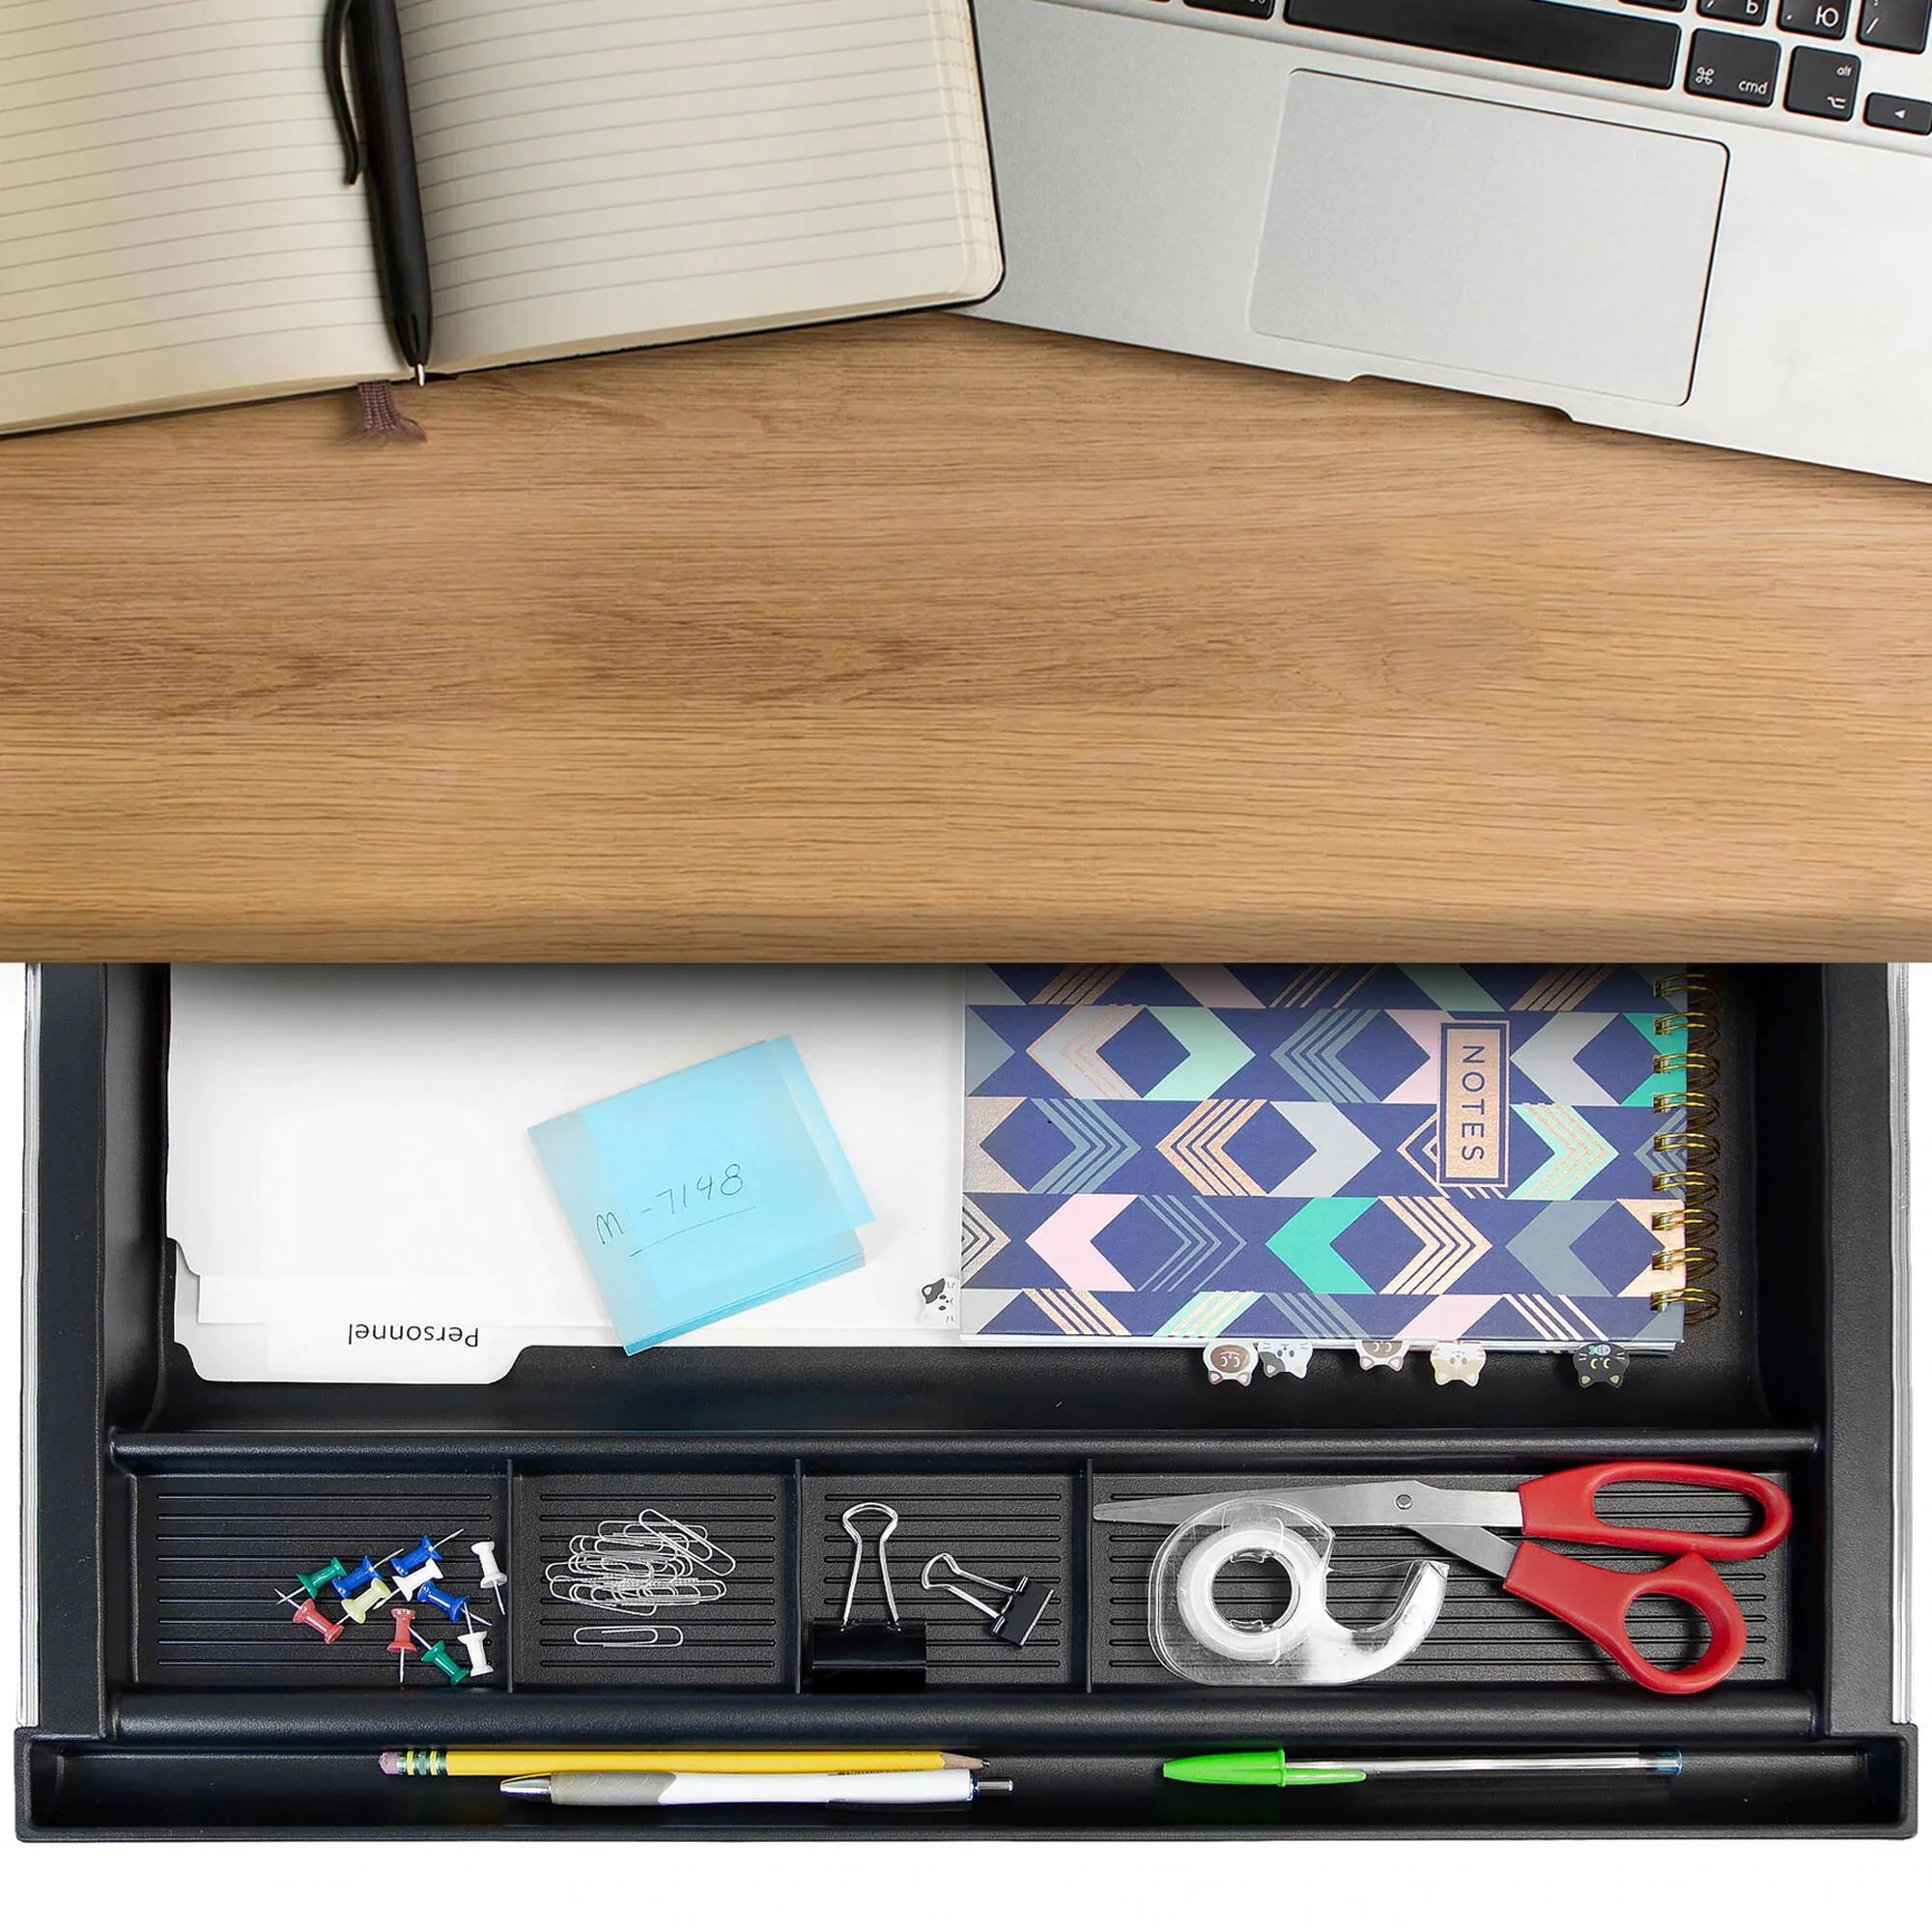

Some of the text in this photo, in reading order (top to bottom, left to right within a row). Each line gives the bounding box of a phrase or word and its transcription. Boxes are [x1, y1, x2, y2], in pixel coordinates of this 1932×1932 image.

[1815, 6, 1839, 27] Ю
[1738, 80, 1768, 95] cmd
[1462, 1045, 1486, 1160] NOTES
[348, 1323, 479, 1348] Personnel
